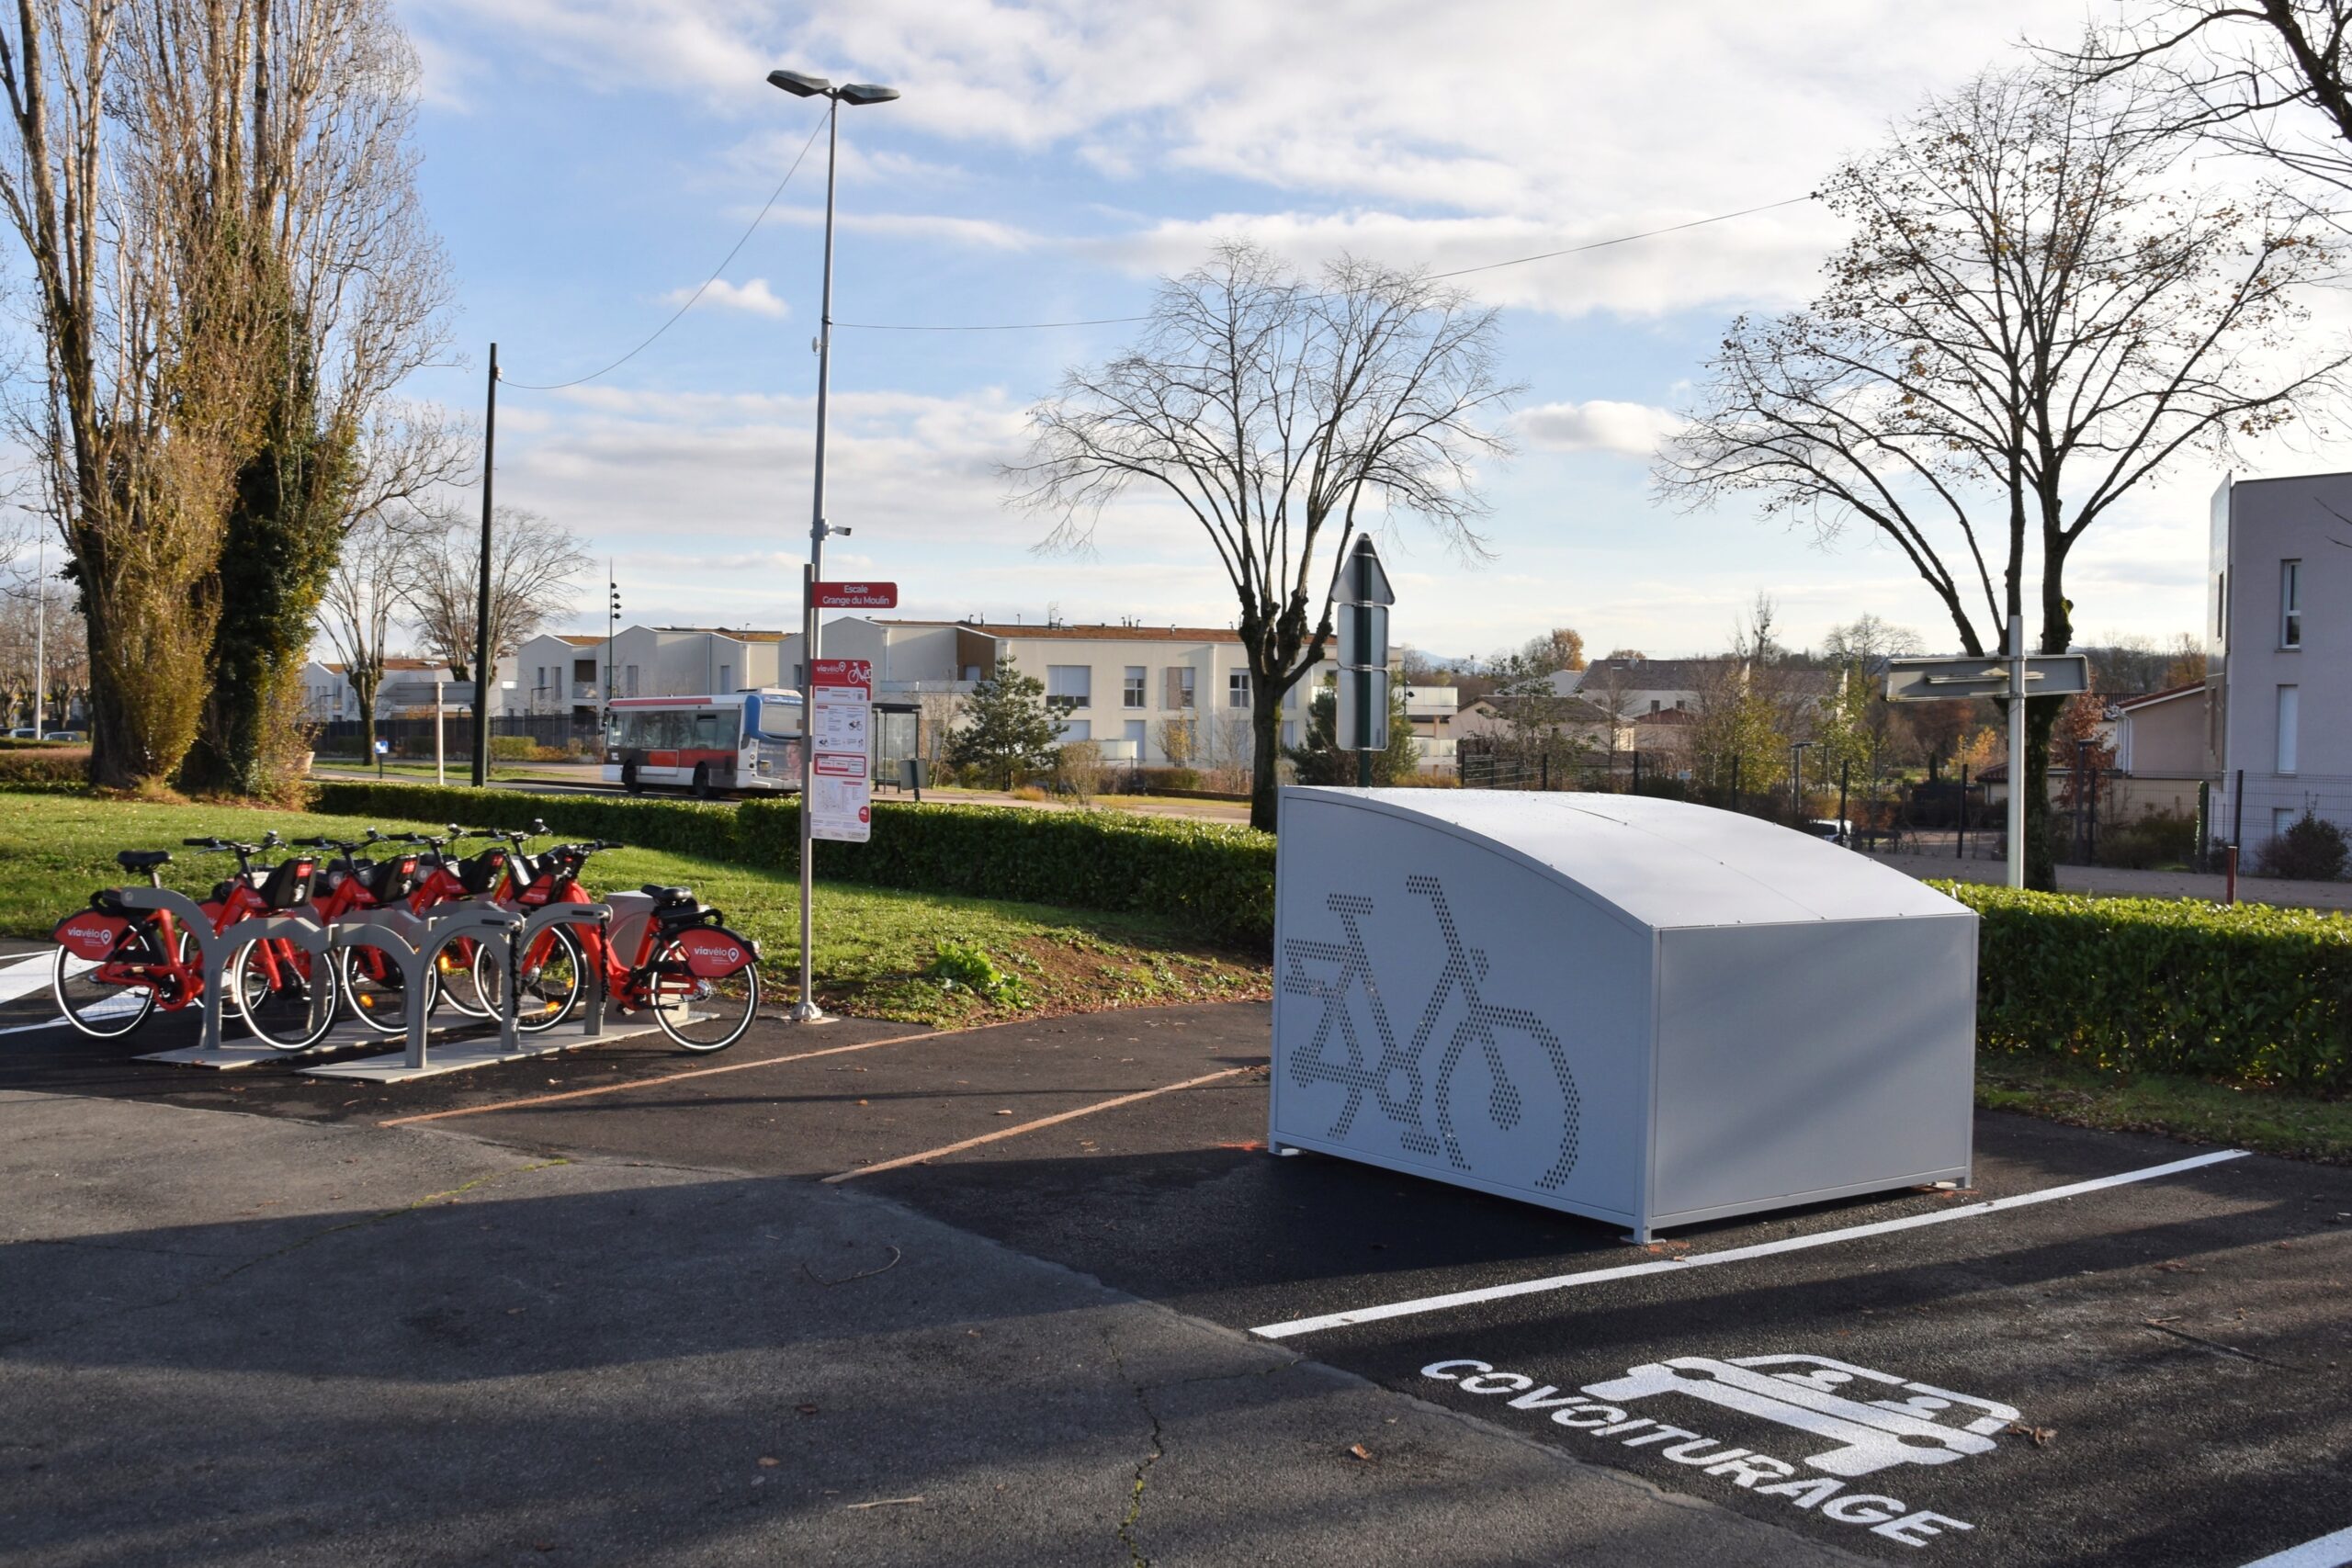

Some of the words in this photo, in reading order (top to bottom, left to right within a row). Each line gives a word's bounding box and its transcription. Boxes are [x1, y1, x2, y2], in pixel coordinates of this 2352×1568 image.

[844, 584, 868, 593] Escale
[822, 596, 851, 606] Grange
[852, 595, 862, 604] du
[864, 595, 889, 604] Moulin
[67, 927, 99, 938] viavélo
[694, 946, 727, 956] viavélo
[1420, 1359, 1974, 1547] COVOITURAGE
